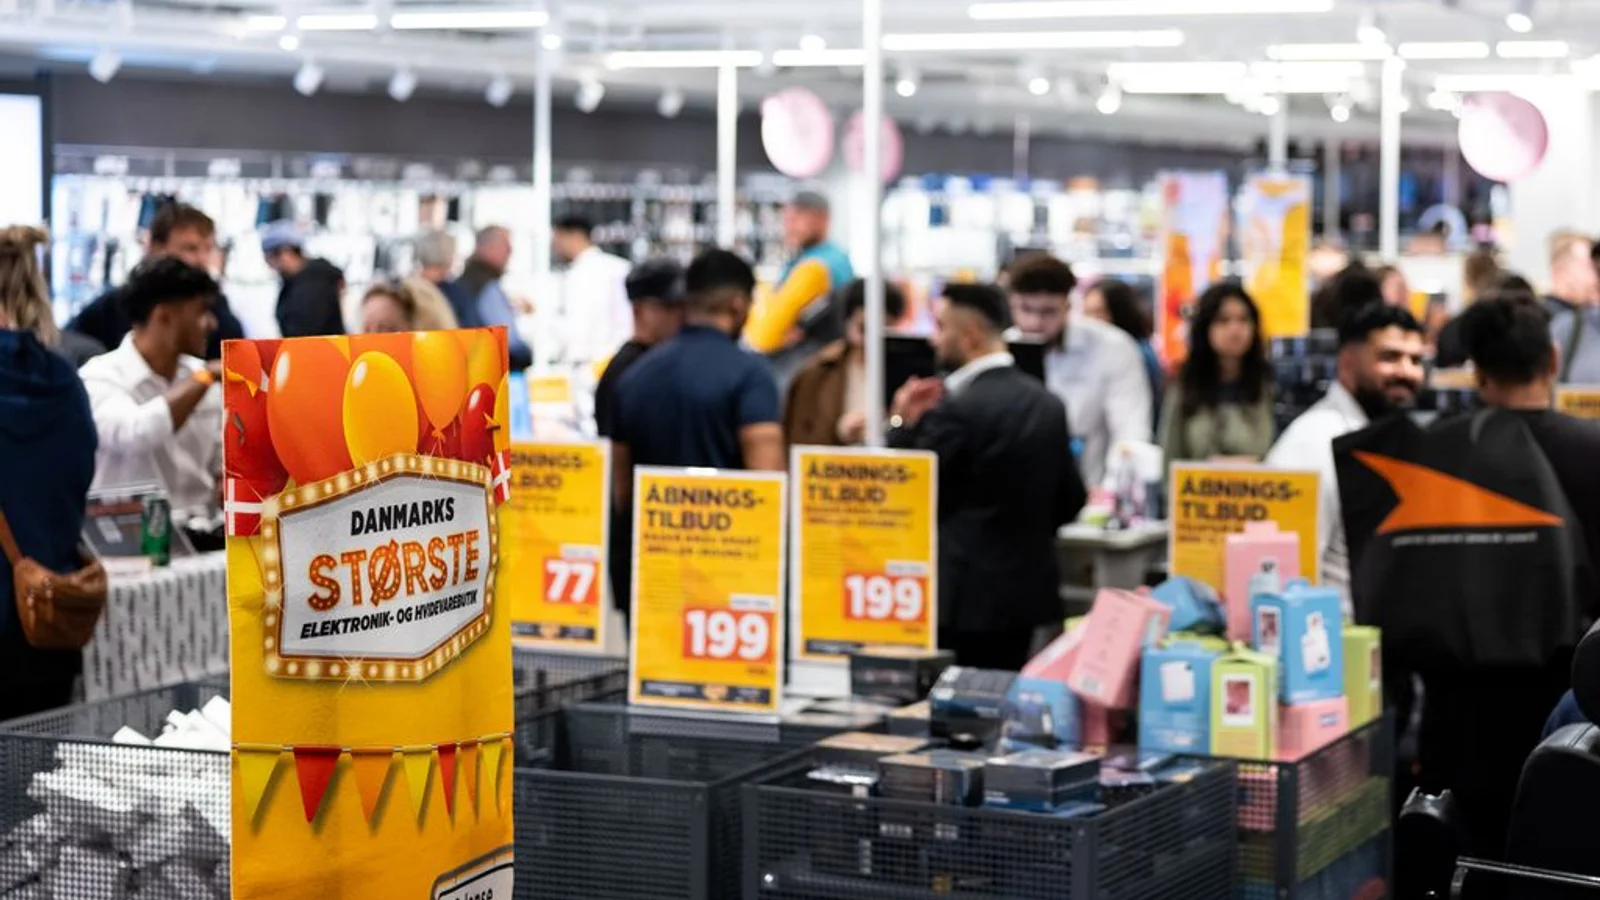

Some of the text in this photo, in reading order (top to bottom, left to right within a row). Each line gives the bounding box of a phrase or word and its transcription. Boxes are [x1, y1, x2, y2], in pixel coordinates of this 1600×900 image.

[645, 482, 765, 509] ÅBNINGS-
[807, 484, 886, 504] TILBUD
[1181, 474, 1301, 501] ÅBNINGS-
[350, 497, 455, 537] DANMARKS
[646, 509, 732, 531] TILBUD
[1180, 501, 1268, 521] TILBUD
[307, 530, 479, 612] STØRSTE
[545, 558, 596, 603] 77
[300, 588, 479, 640] ELEKTRONIK- OG HVIDEVAREBUTIK
[845, 575, 922, 621] 199
[686, 609, 769, 660] 199
